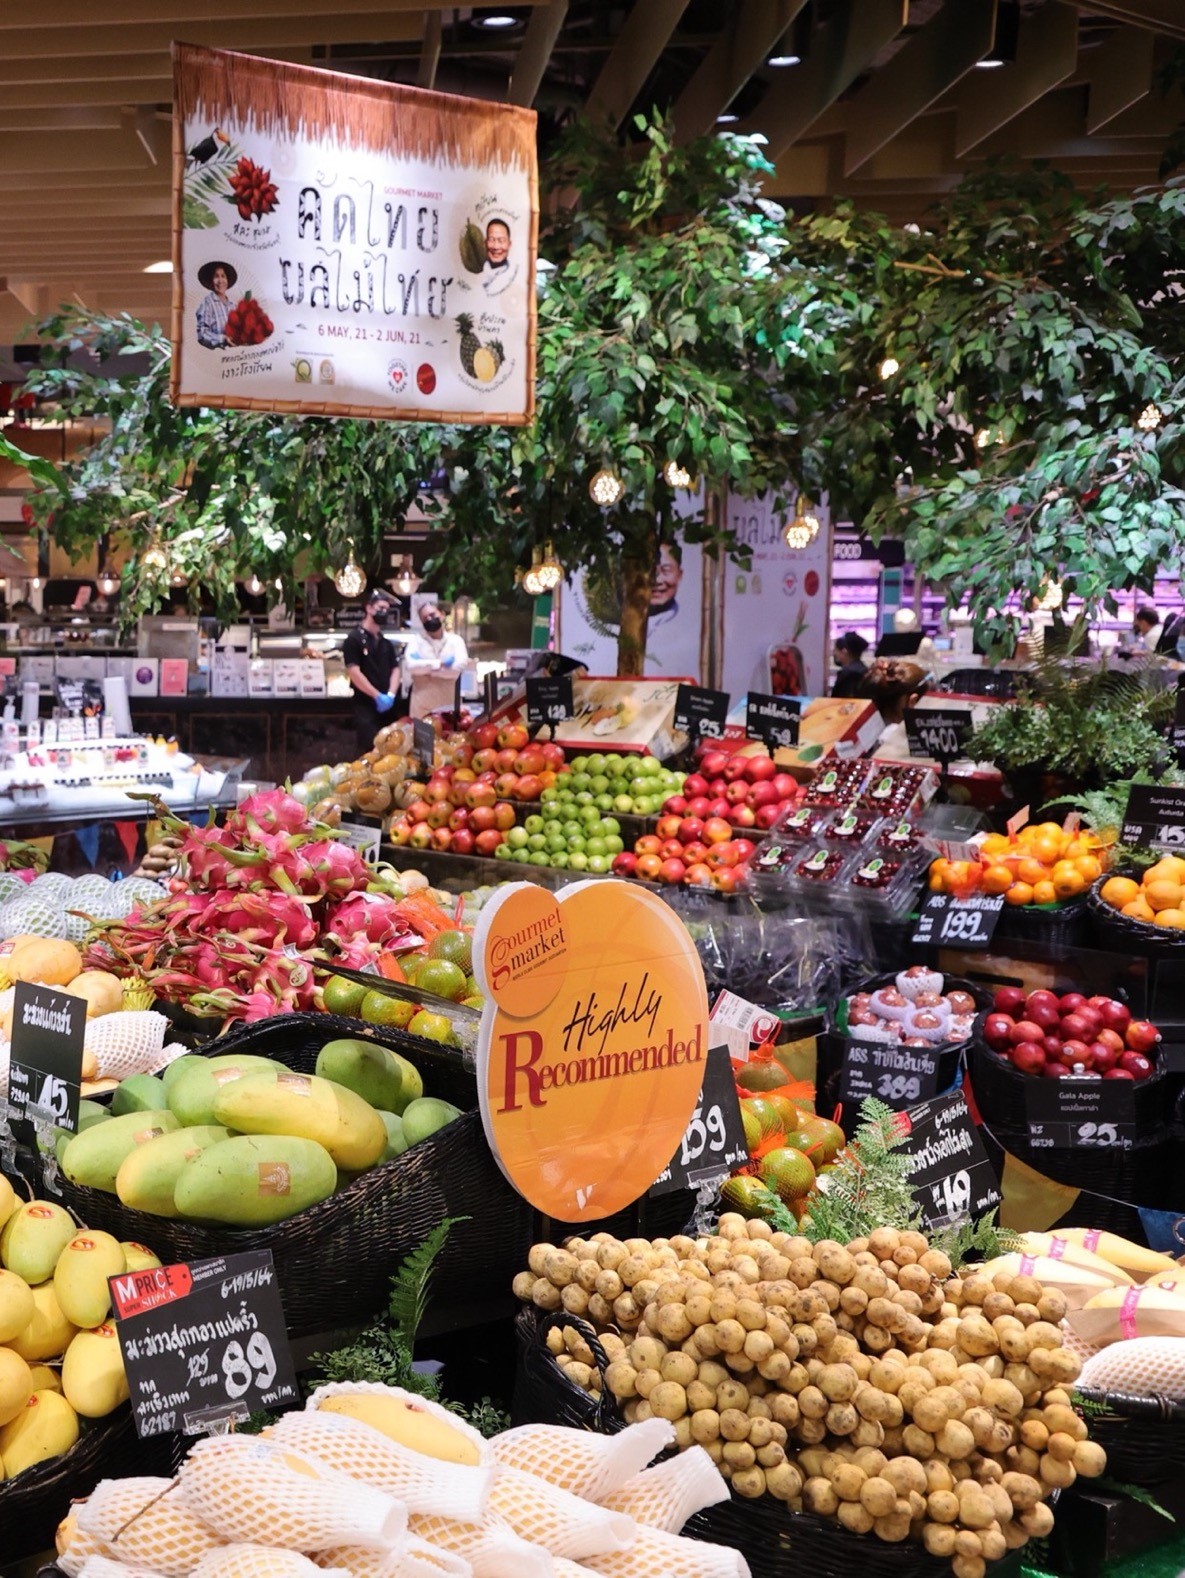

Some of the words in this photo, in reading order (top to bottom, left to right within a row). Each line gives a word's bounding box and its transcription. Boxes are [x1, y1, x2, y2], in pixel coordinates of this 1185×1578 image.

[298, 170, 439, 253] คัดไทย
[384, 186, 416, 198] GOURMET
[417, 190, 443, 201] MARKET
[318, 324, 325, 337] 6
[327, 325, 353, 340] MAY,
[355, 327, 368, 340] 21
[376, 329, 383, 342] 2
[385, 330, 408, 344] JUN,
[409, 332, 421, 345] 21
[490, 907, 562, 961] Gourmet
[940, 911, 983, 939] 199
[510, 926, 566, 971] market
[562, 972, 663, 1056] Highly
[497, 1024, 703, 1115] Recommended
[877, 1073, 921, 1100] 389
[37, 1073, 69, 1118] 45
[1059, 1092, 1076, 1100] Gala
[1078, 1092, 1101, 1101] Apple
[1077, 1122, 1119, 1147] 25
[192, 1271, 214, 1283] MEMBER
[213, 1265, 227, 1276] ONLY
[221, 1331, 277, 1400] 89
